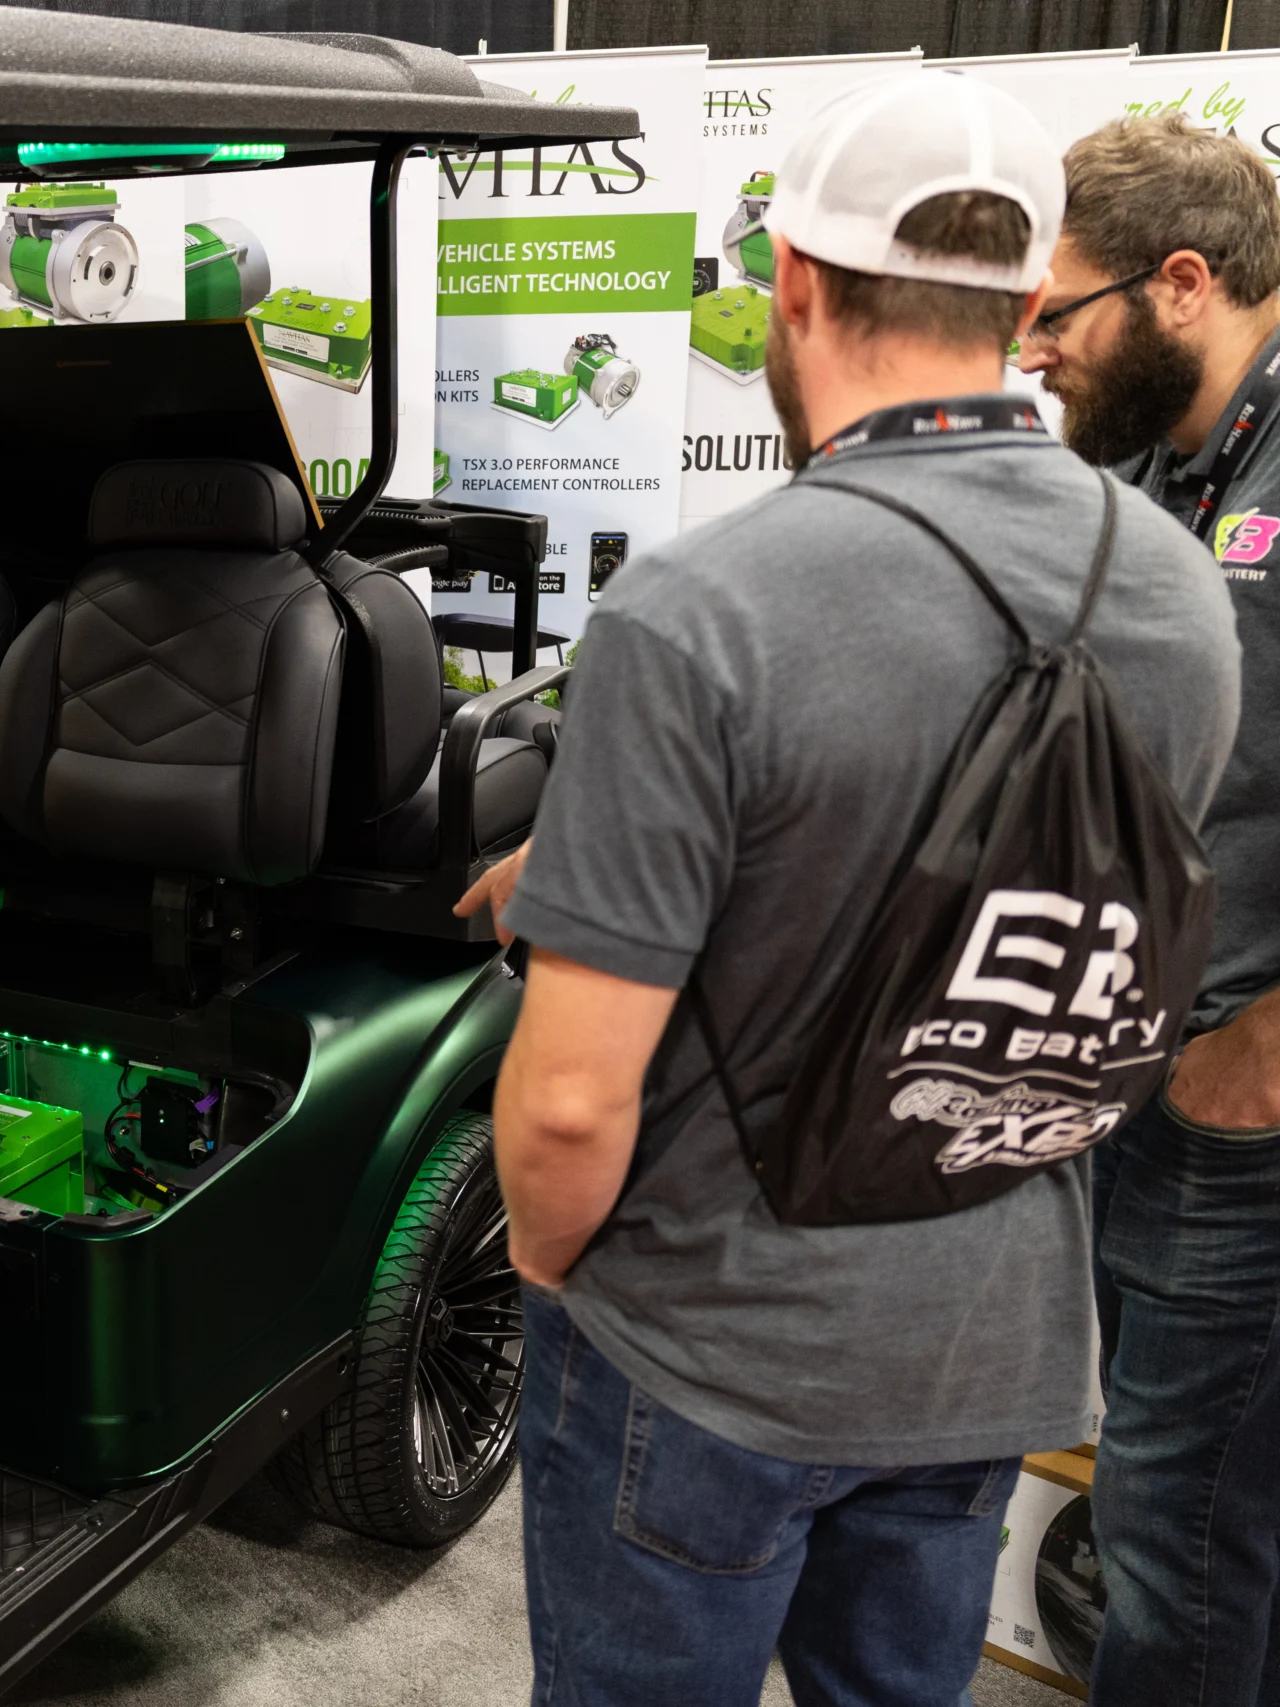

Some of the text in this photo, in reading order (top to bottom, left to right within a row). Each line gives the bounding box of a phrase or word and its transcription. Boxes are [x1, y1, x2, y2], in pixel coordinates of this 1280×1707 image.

[703, 88, 776, 118] ITAS
[1203, 82, 1246, 128] by
[703, 123, 768, 137] SYSTEMS
[436, 240, 616, 263] VEHICLE SYSTEMS
[525, 270, 671, 292] TECHNOLOGY
[450, 390, 480, 403] KITS
[462, 458, 487, 471] TSX
[516, 457, 620, 471] PERFORMANCE
[461, 477, 661, 491] REPLACEMENT CONTROLLERS
